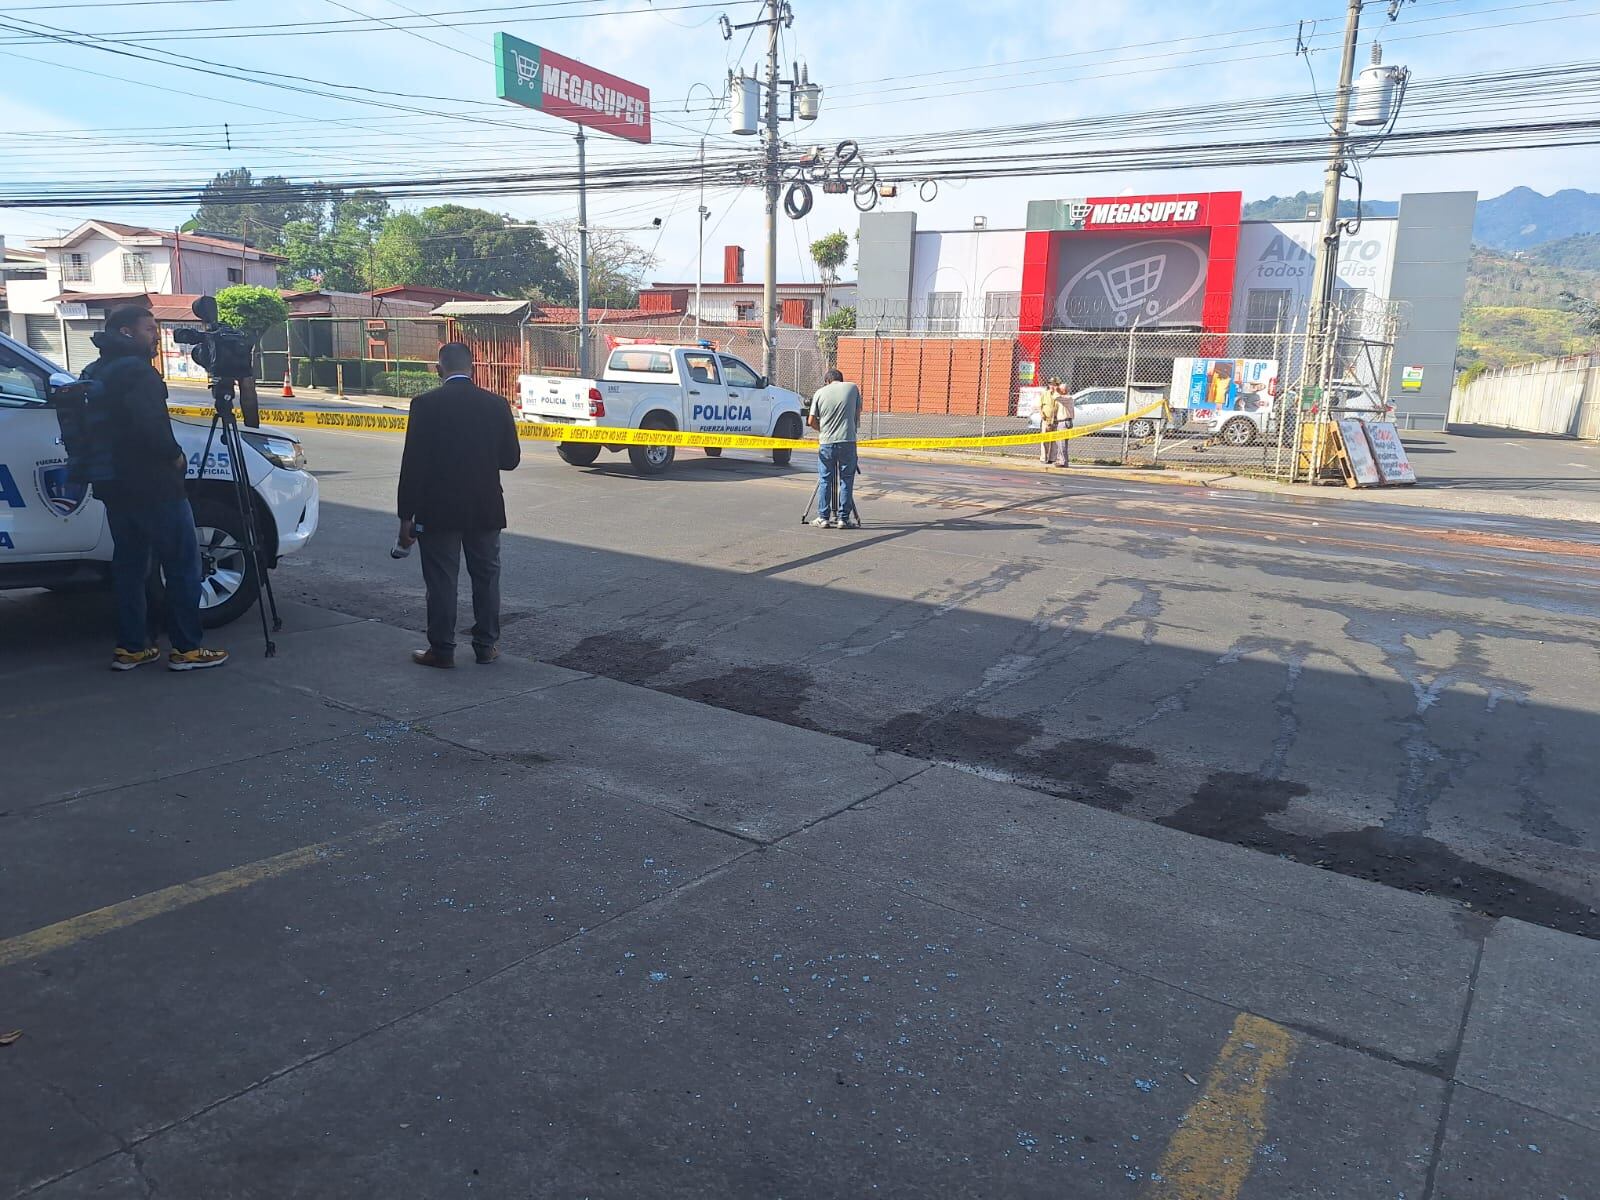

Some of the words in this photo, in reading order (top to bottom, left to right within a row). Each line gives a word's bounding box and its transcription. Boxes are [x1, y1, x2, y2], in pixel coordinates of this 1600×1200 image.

[542, 64, 645, 127] MEGASUPER
[1090, 200, 1199, 225] MEGASUPER
[1258, 233, 1382, 262] Ahro
[1257, 264, 1306, 278] todos
[540, 396, 567, 405] POLICIA
[693, 404, 752, 421] POLICIA
